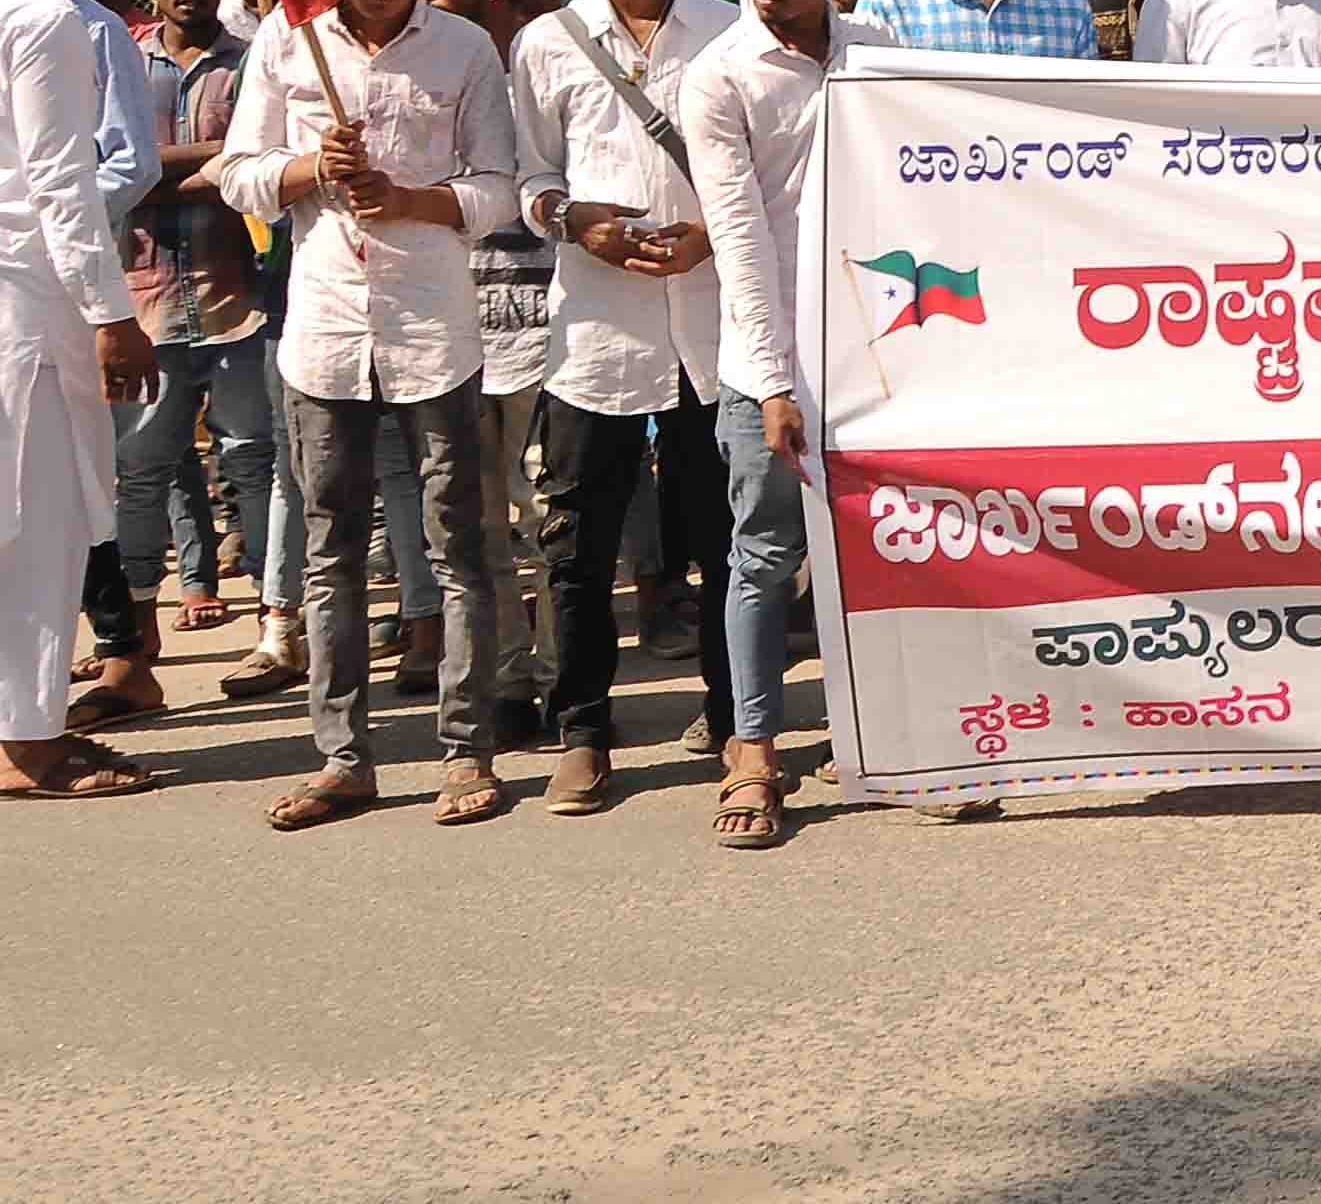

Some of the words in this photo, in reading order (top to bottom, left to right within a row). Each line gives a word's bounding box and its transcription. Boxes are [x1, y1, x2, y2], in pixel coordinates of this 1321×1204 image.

[899, 131, 1133, 183] ಜಾರ್ಖಂಡ್
[959, 692, 1052, 758] ಸ್ಥಳ
[1122, 680, 1293, 730] ಹಾಸನ
